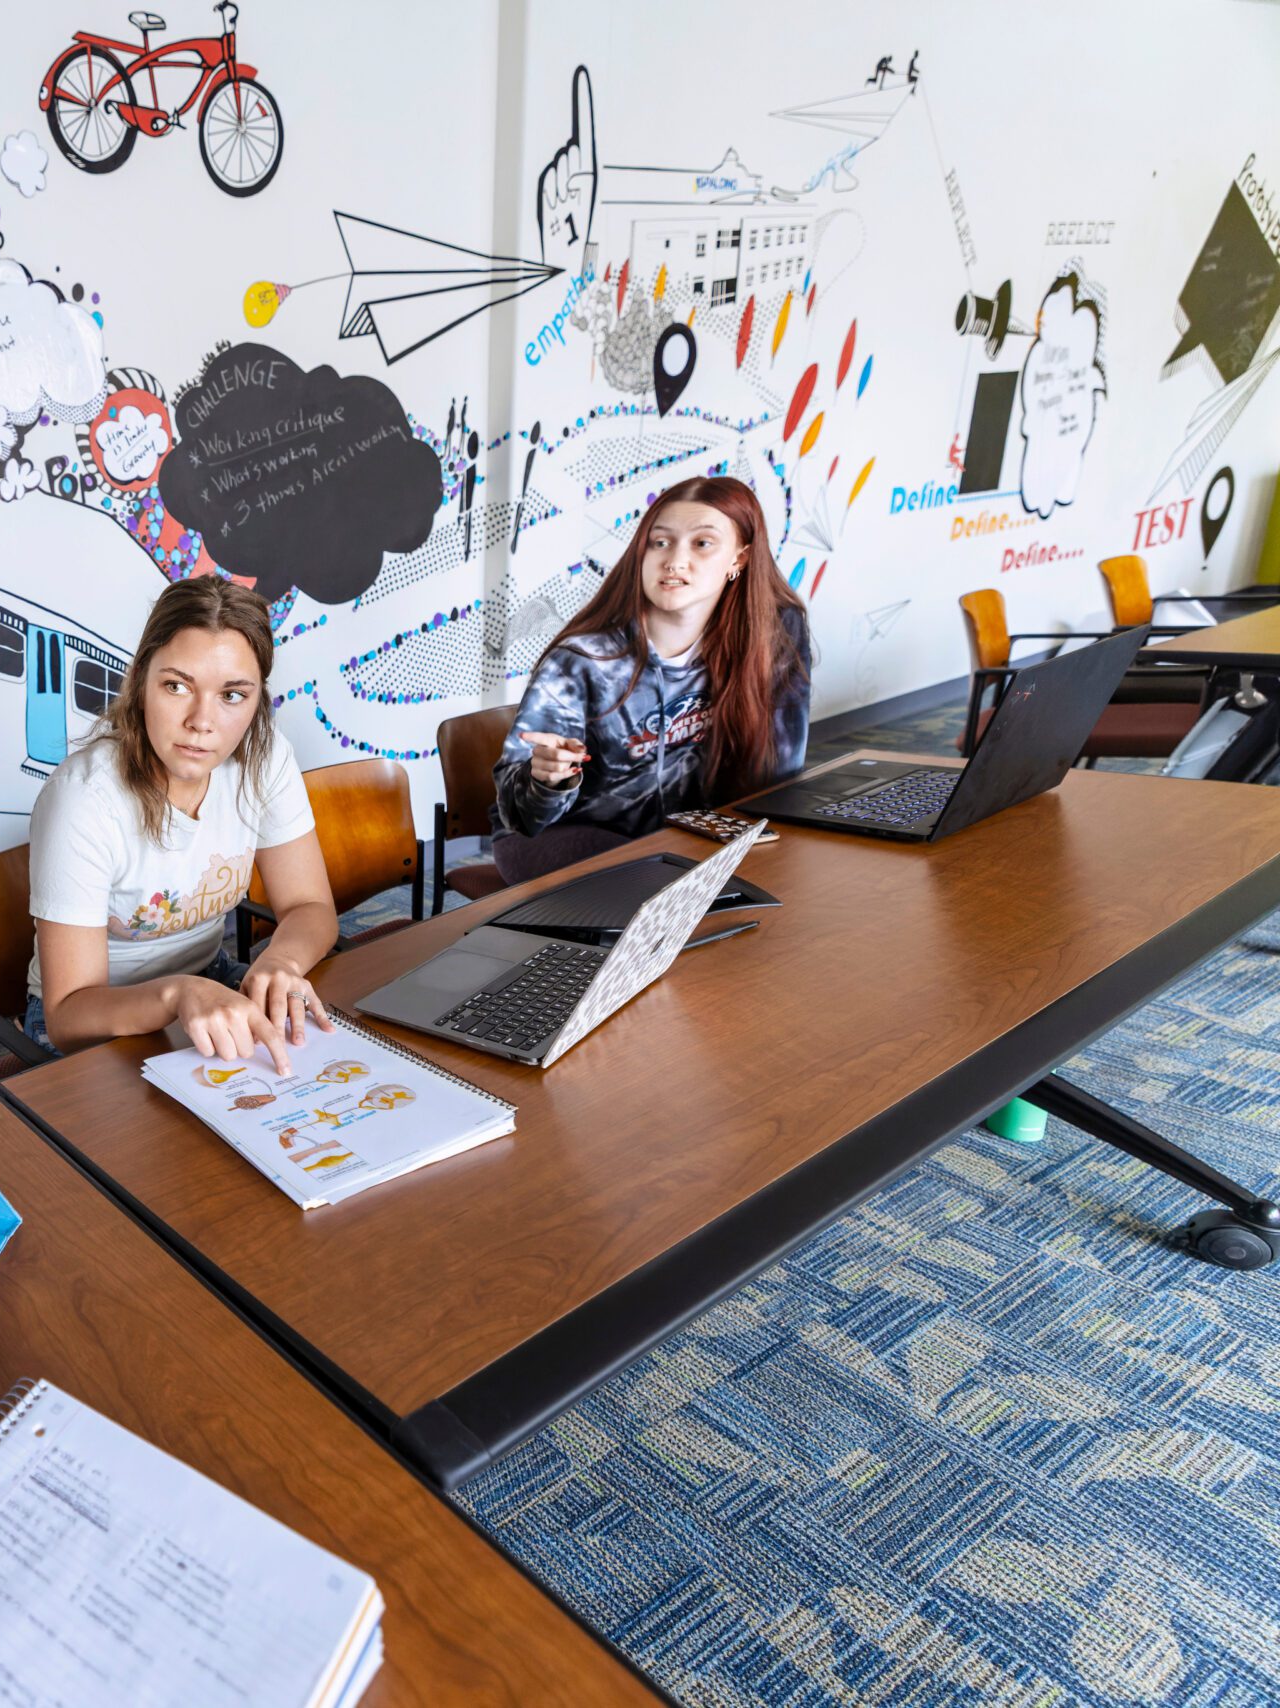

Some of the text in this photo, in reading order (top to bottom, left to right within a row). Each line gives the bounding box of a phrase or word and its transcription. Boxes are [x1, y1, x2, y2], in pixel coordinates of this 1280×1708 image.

[1045, 222, 1115, 246] REFLECT
[186, 360, 287, 429] CHALLENGE
[235, 499, 250, 527] 3
[1132, 498, 1195, 551] TEST
